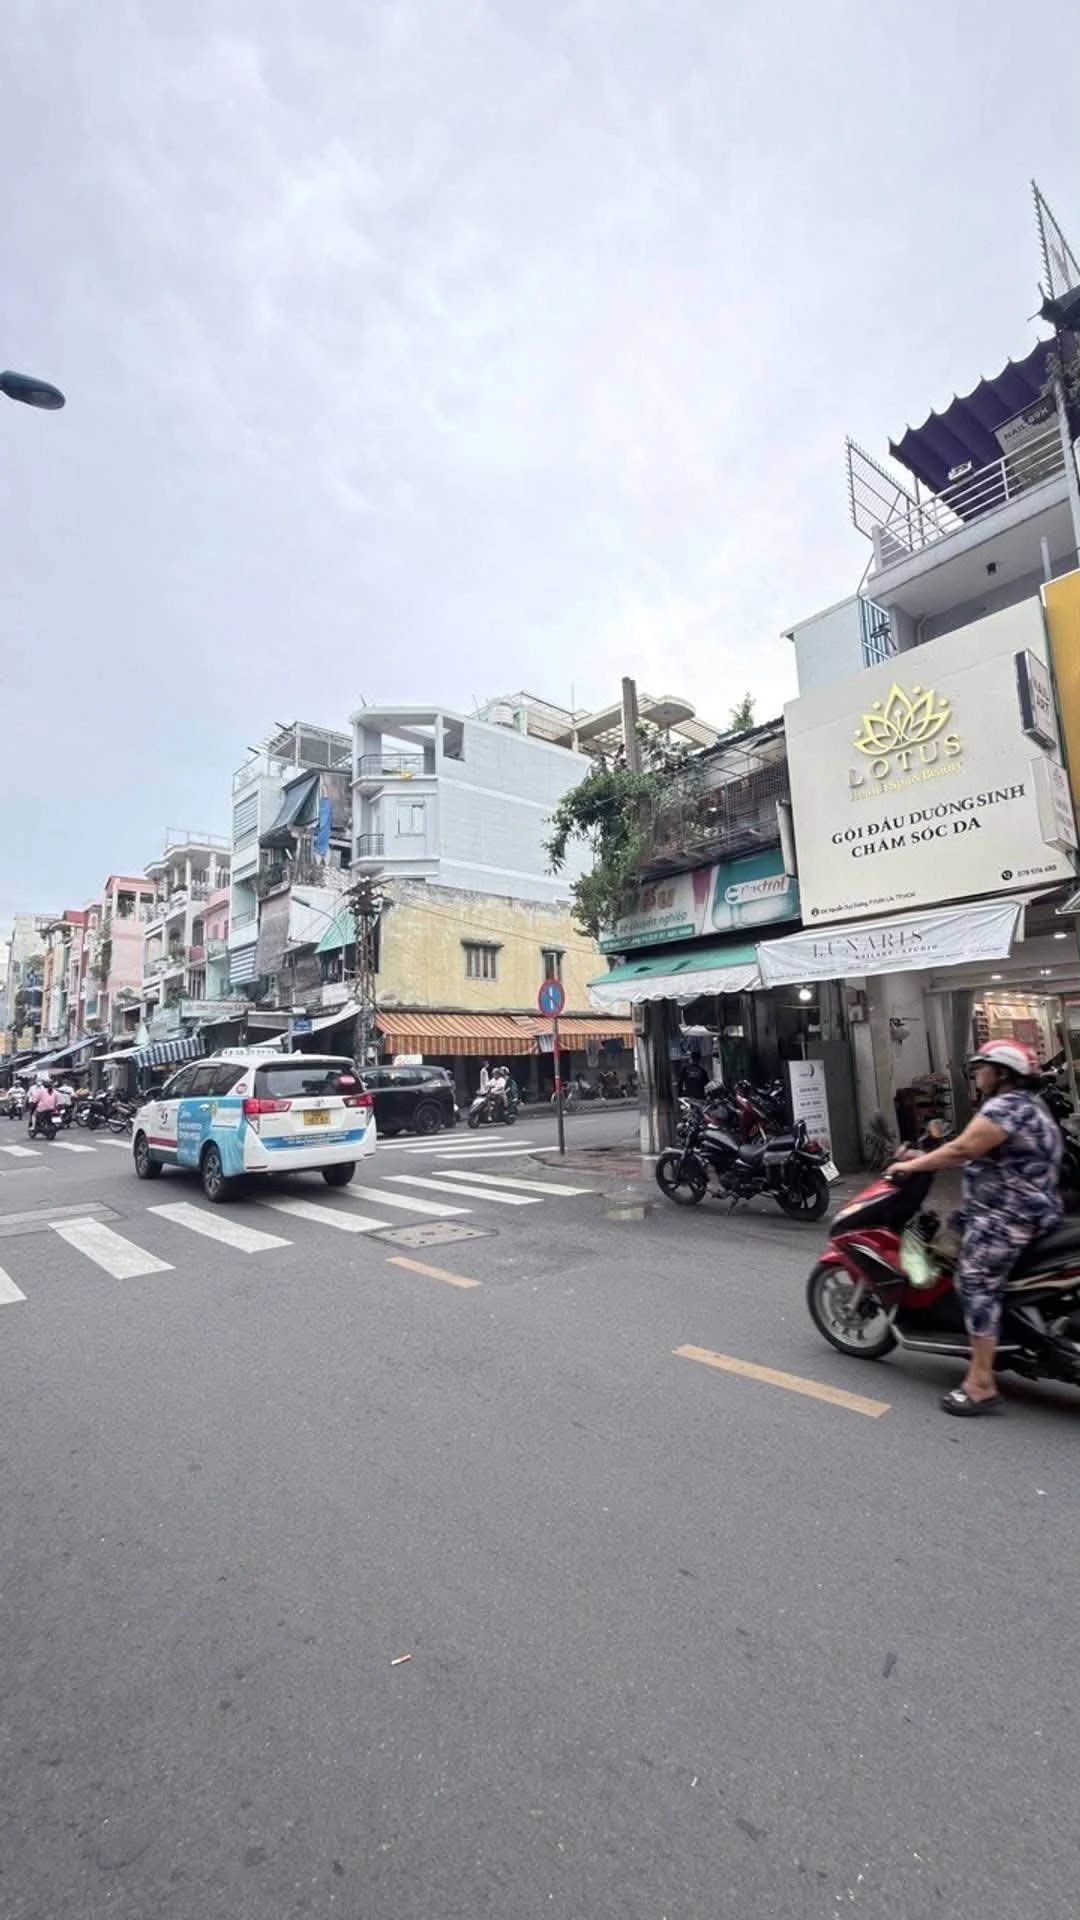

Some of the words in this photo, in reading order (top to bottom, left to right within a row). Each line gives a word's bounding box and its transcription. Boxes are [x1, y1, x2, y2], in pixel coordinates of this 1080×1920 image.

[848, 734, 963, 788] LOTUS
[976, 784, 1026, 807] SINH
[911, 824, 948, 844] SÓC
[952, 817, 981, 834] DA
